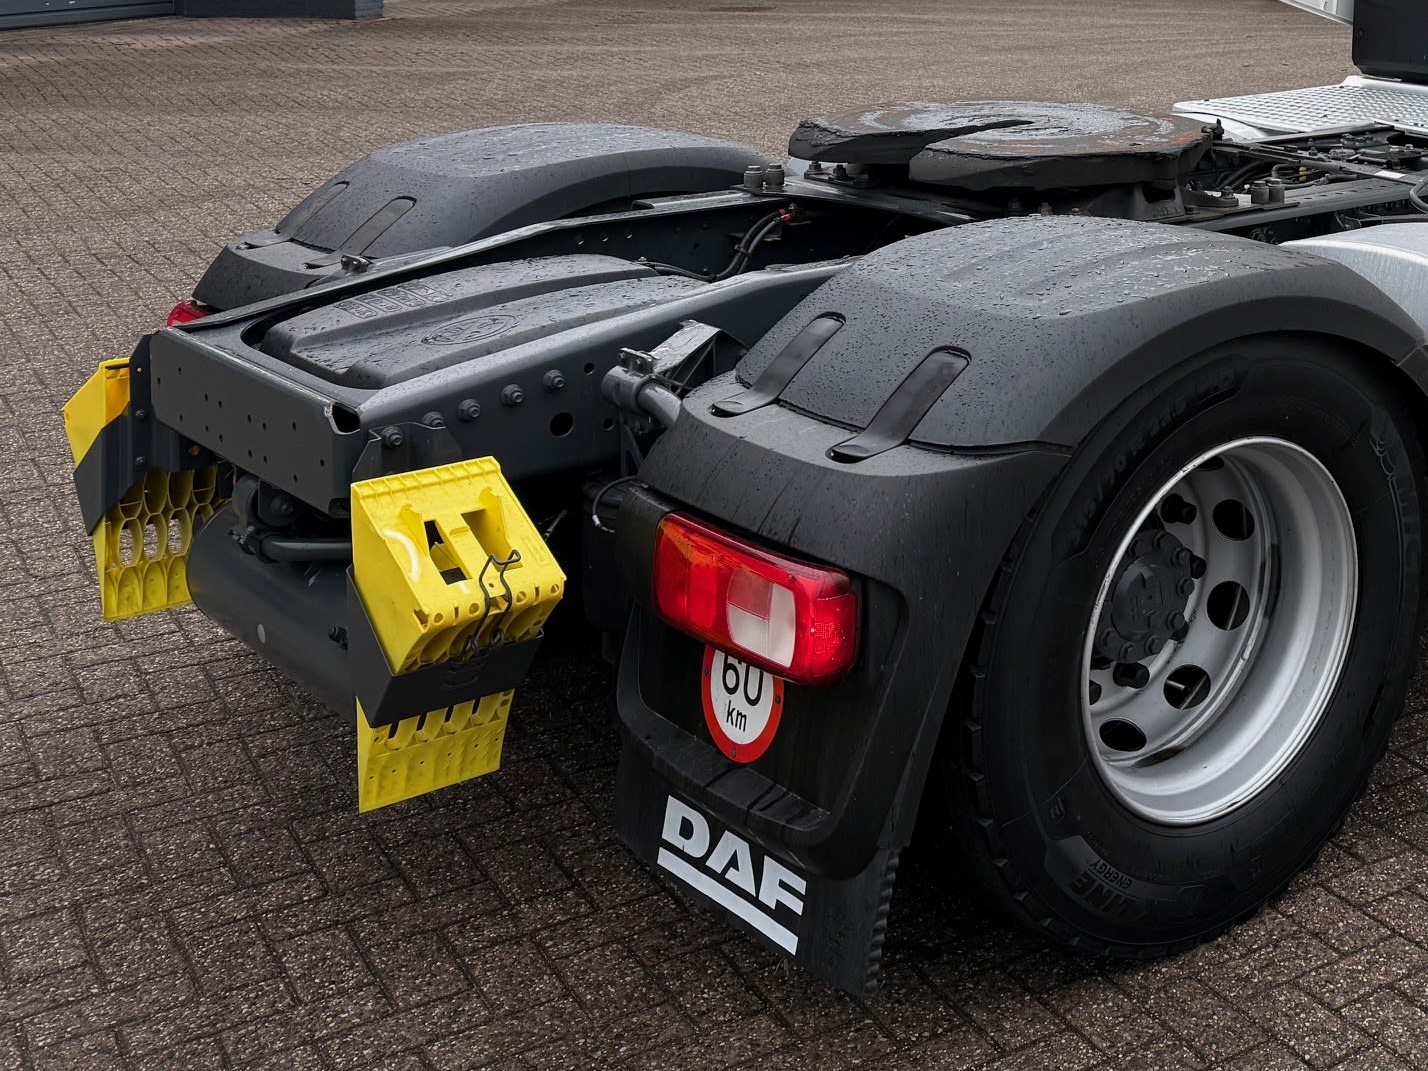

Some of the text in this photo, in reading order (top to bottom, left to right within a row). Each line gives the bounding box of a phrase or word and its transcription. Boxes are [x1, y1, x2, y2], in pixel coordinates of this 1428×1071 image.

[720, 651, 765, 708] 60
[726, 699, 748, 733] km
[660, 794, 807, 916] DAF
[1089, 859, 1133, 890] ENERGY
